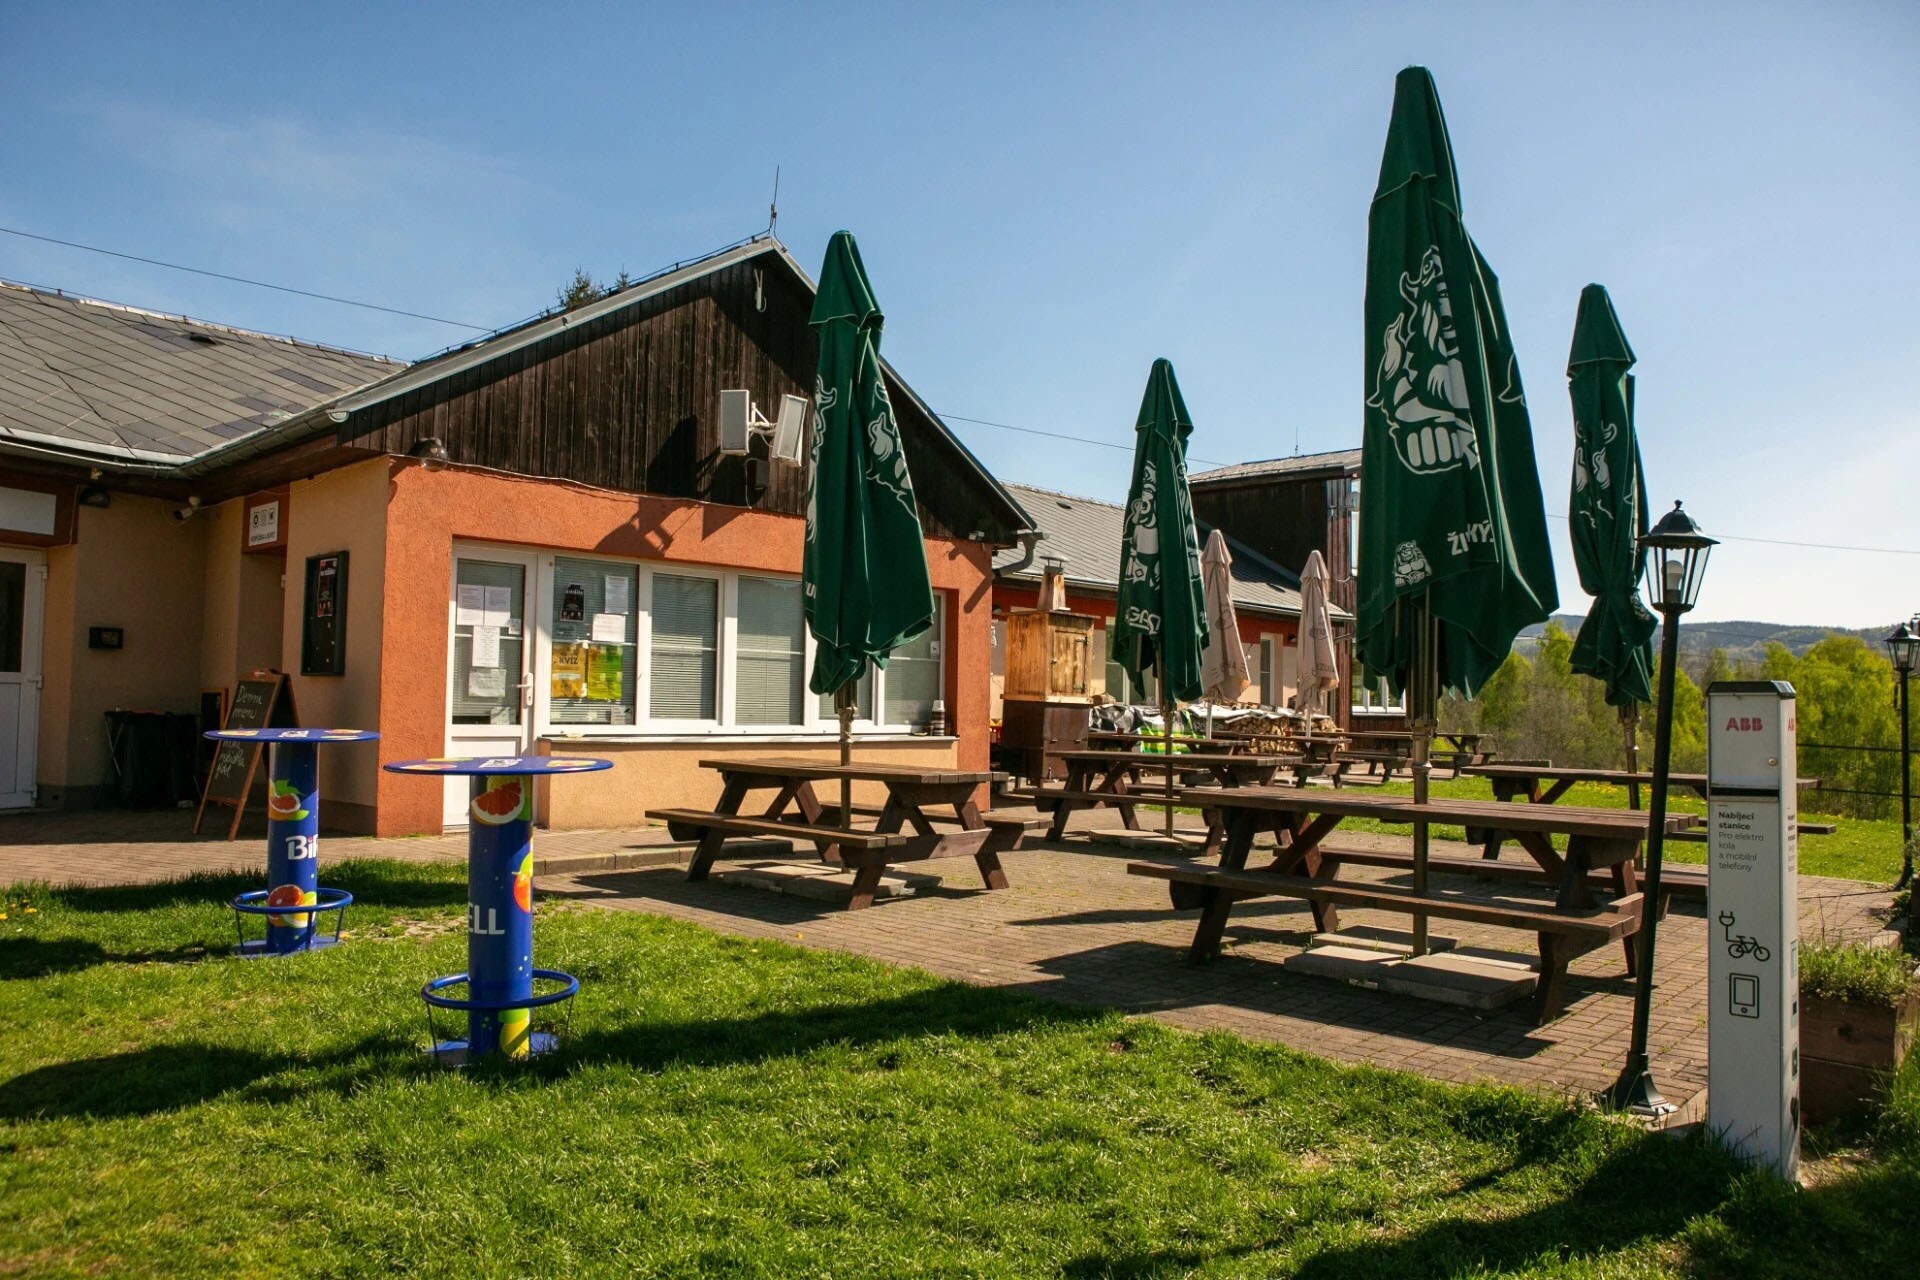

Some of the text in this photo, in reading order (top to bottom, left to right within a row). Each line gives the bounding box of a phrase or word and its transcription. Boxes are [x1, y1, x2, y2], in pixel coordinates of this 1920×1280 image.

[1726, 717, 1763, 732] ABB
[1718, 811, 1755, 821] Nabíjecí
[1718, 822, 1751, 831] stanice
[1718, 832, 1764, 842] Pro elektro
[1718, 841, 1736, 850] kola
[1725, 851, 1757, 862] mobilní
[1718, 862, 1753, 873] telefony
